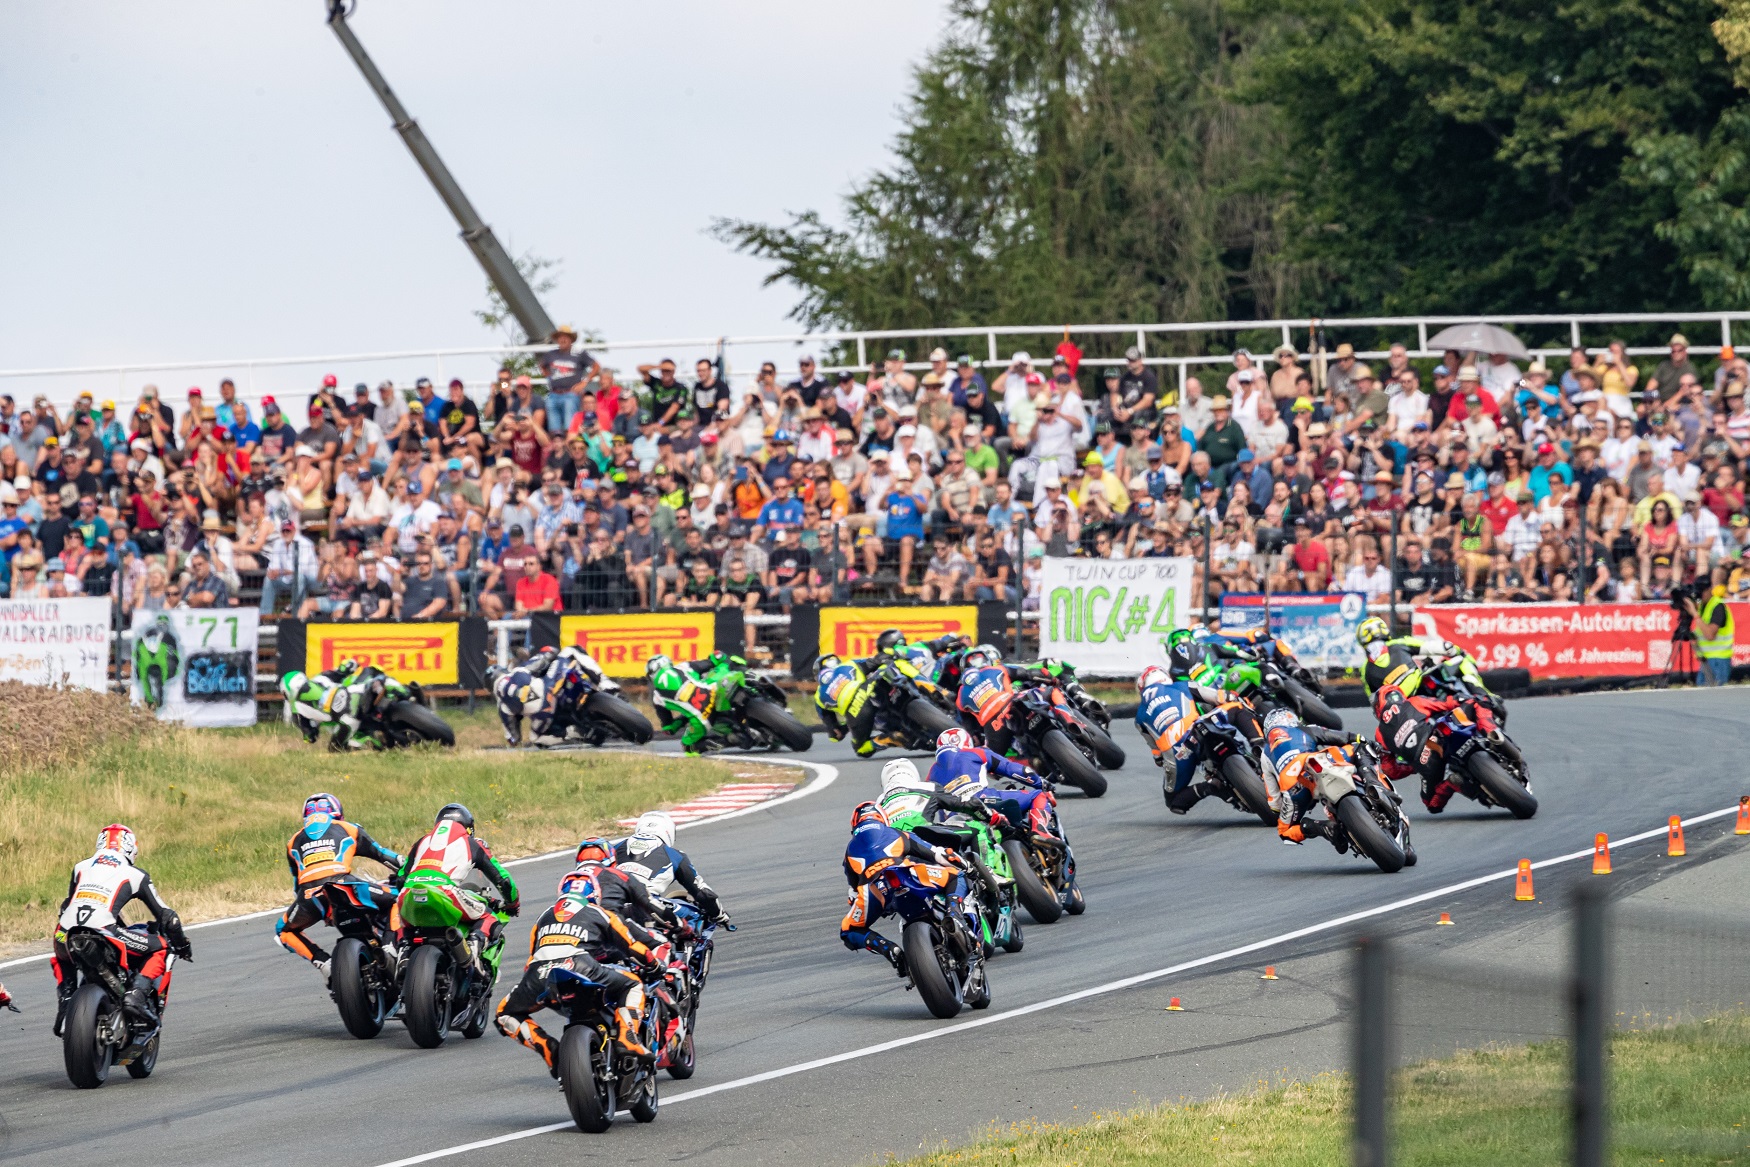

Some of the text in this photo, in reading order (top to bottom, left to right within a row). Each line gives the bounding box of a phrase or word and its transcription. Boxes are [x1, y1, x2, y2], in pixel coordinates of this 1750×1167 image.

[1119, 564, 1147, 580] CUP
[0, 622, 106, 643] ALDKRAIBURG
[1454, 609, 1672, 638] Sparkassen-Autokredit
[1475, 642, 1521, 670] 2,99
[1525, 642, 1549, 667] %
[537, 922, 589, 943] YAMAHA
